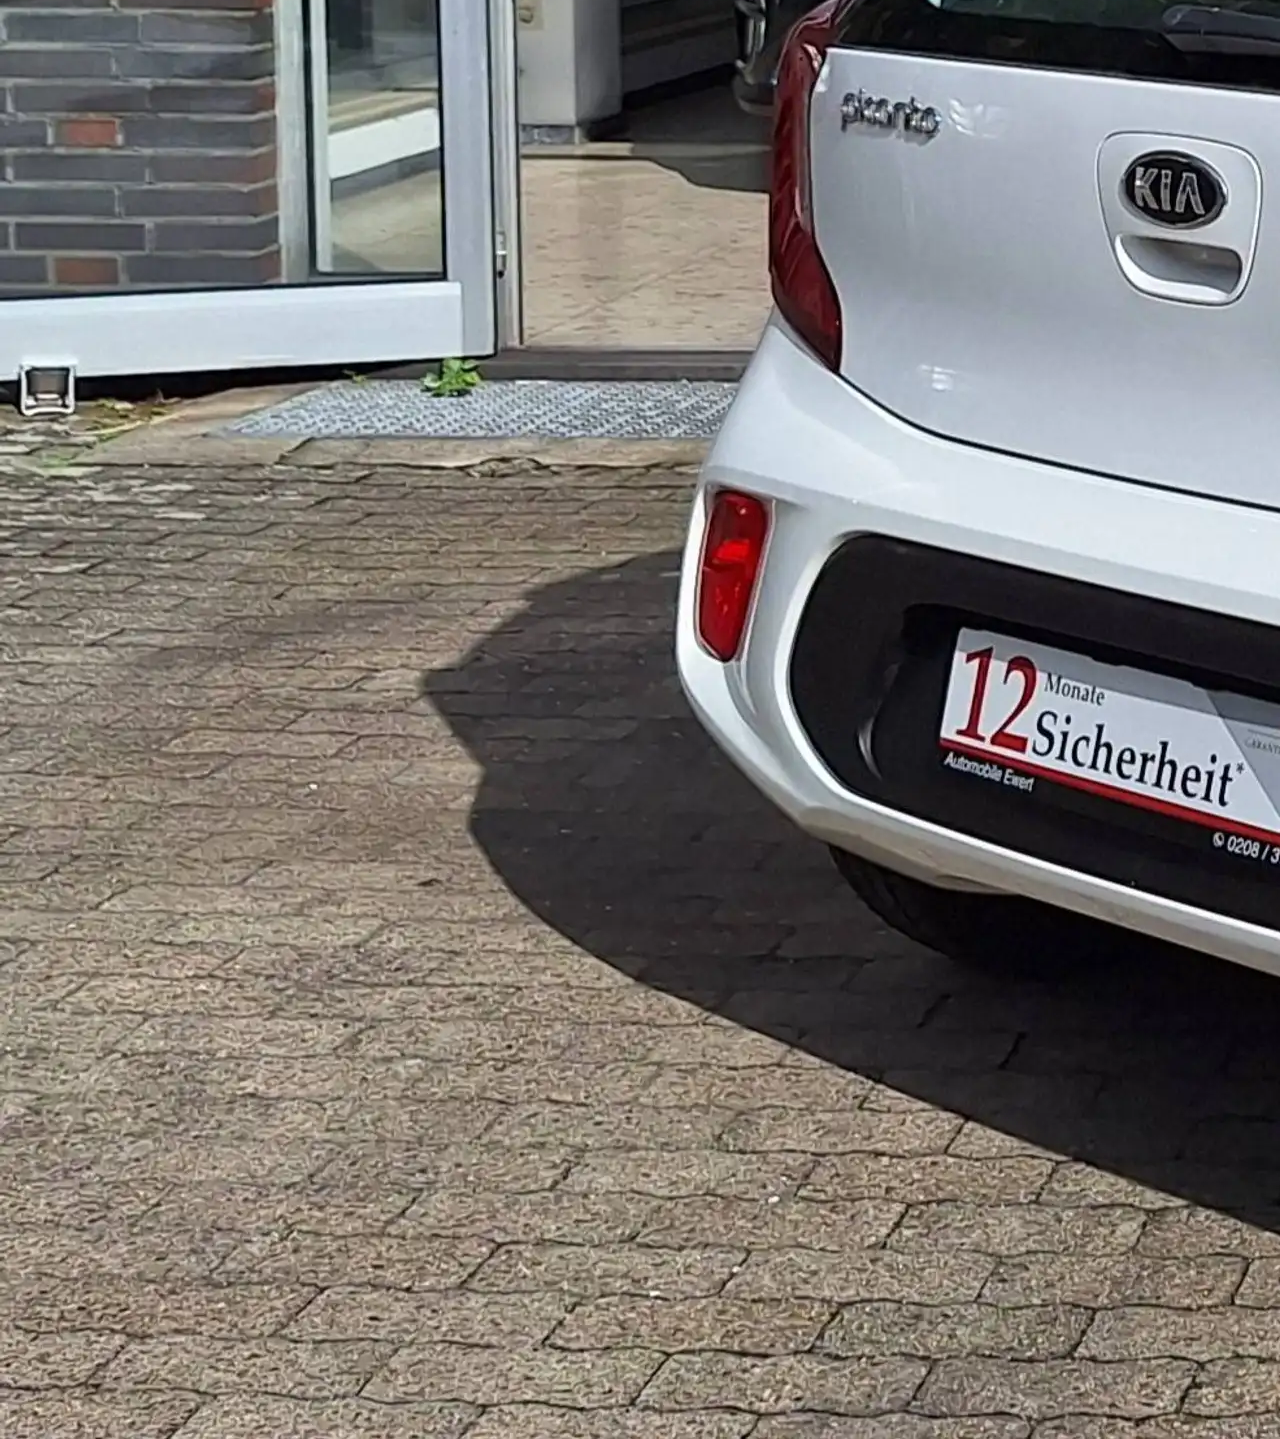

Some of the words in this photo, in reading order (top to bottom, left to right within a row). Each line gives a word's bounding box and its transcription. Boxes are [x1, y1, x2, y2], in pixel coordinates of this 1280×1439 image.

[840, 88, 942, 135] picanto
[1134, 165, 1206, 215] KIA
[955, 645, 1039, 754] 12
[1044, 672, 1106, 706] Monate
[943, 751, 1003, 782] Automobile
[1003, 768, 1035, 793] Ewert
[1227, 835, 1260, 859] 0208
